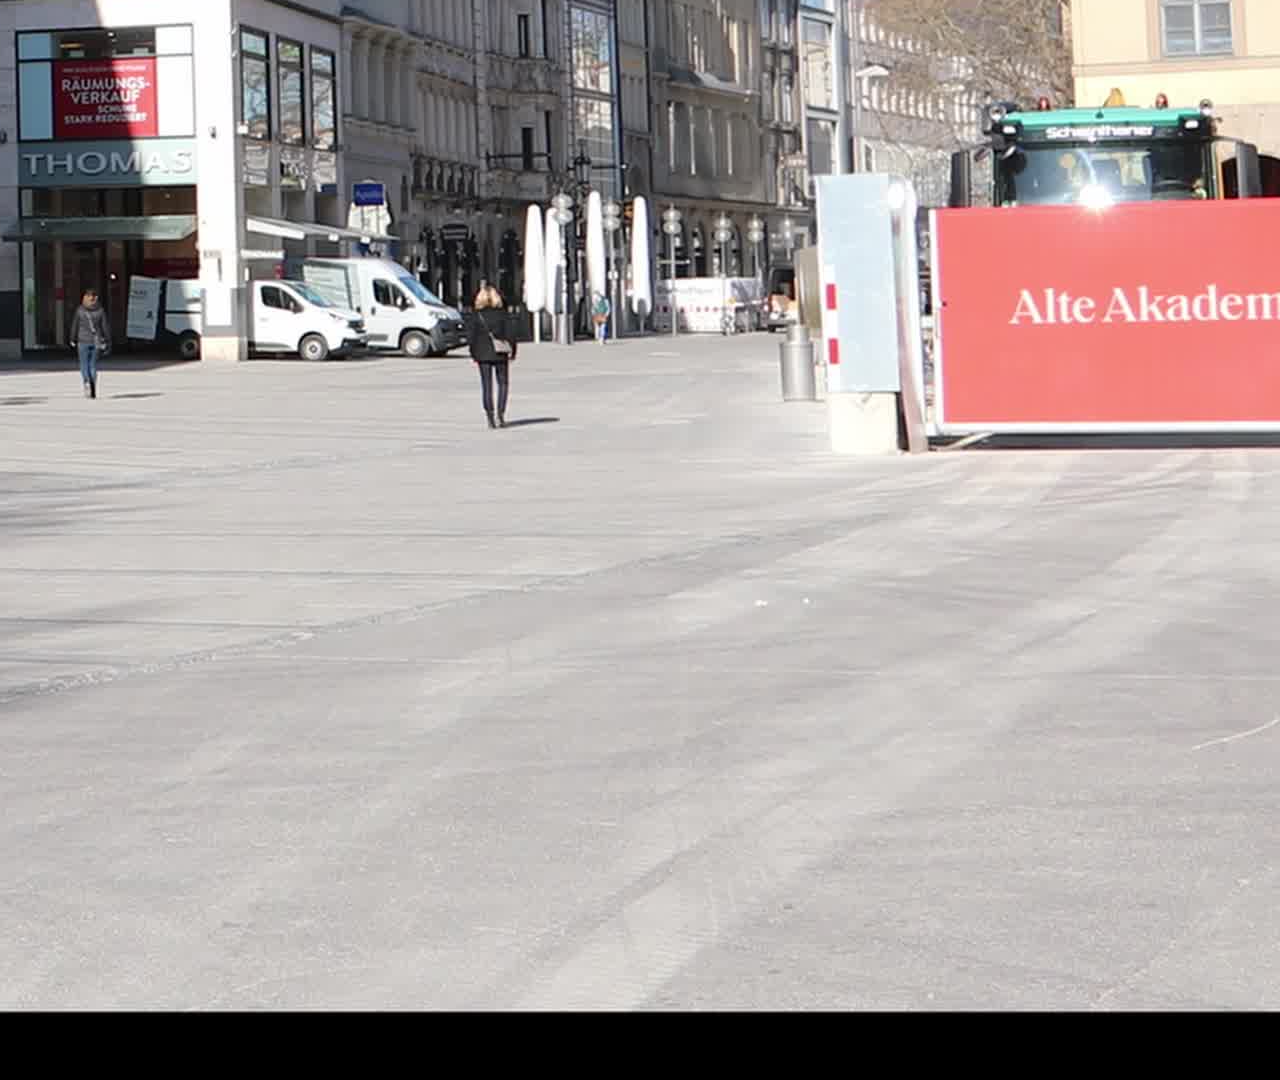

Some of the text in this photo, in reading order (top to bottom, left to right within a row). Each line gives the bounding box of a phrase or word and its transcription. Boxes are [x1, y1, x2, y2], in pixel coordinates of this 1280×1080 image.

[71, 90, 141, 104] VERKAUF
[23, 151, 193, 176] THOMAS
[1008, 282, 1280, 325] Alte Akadem
